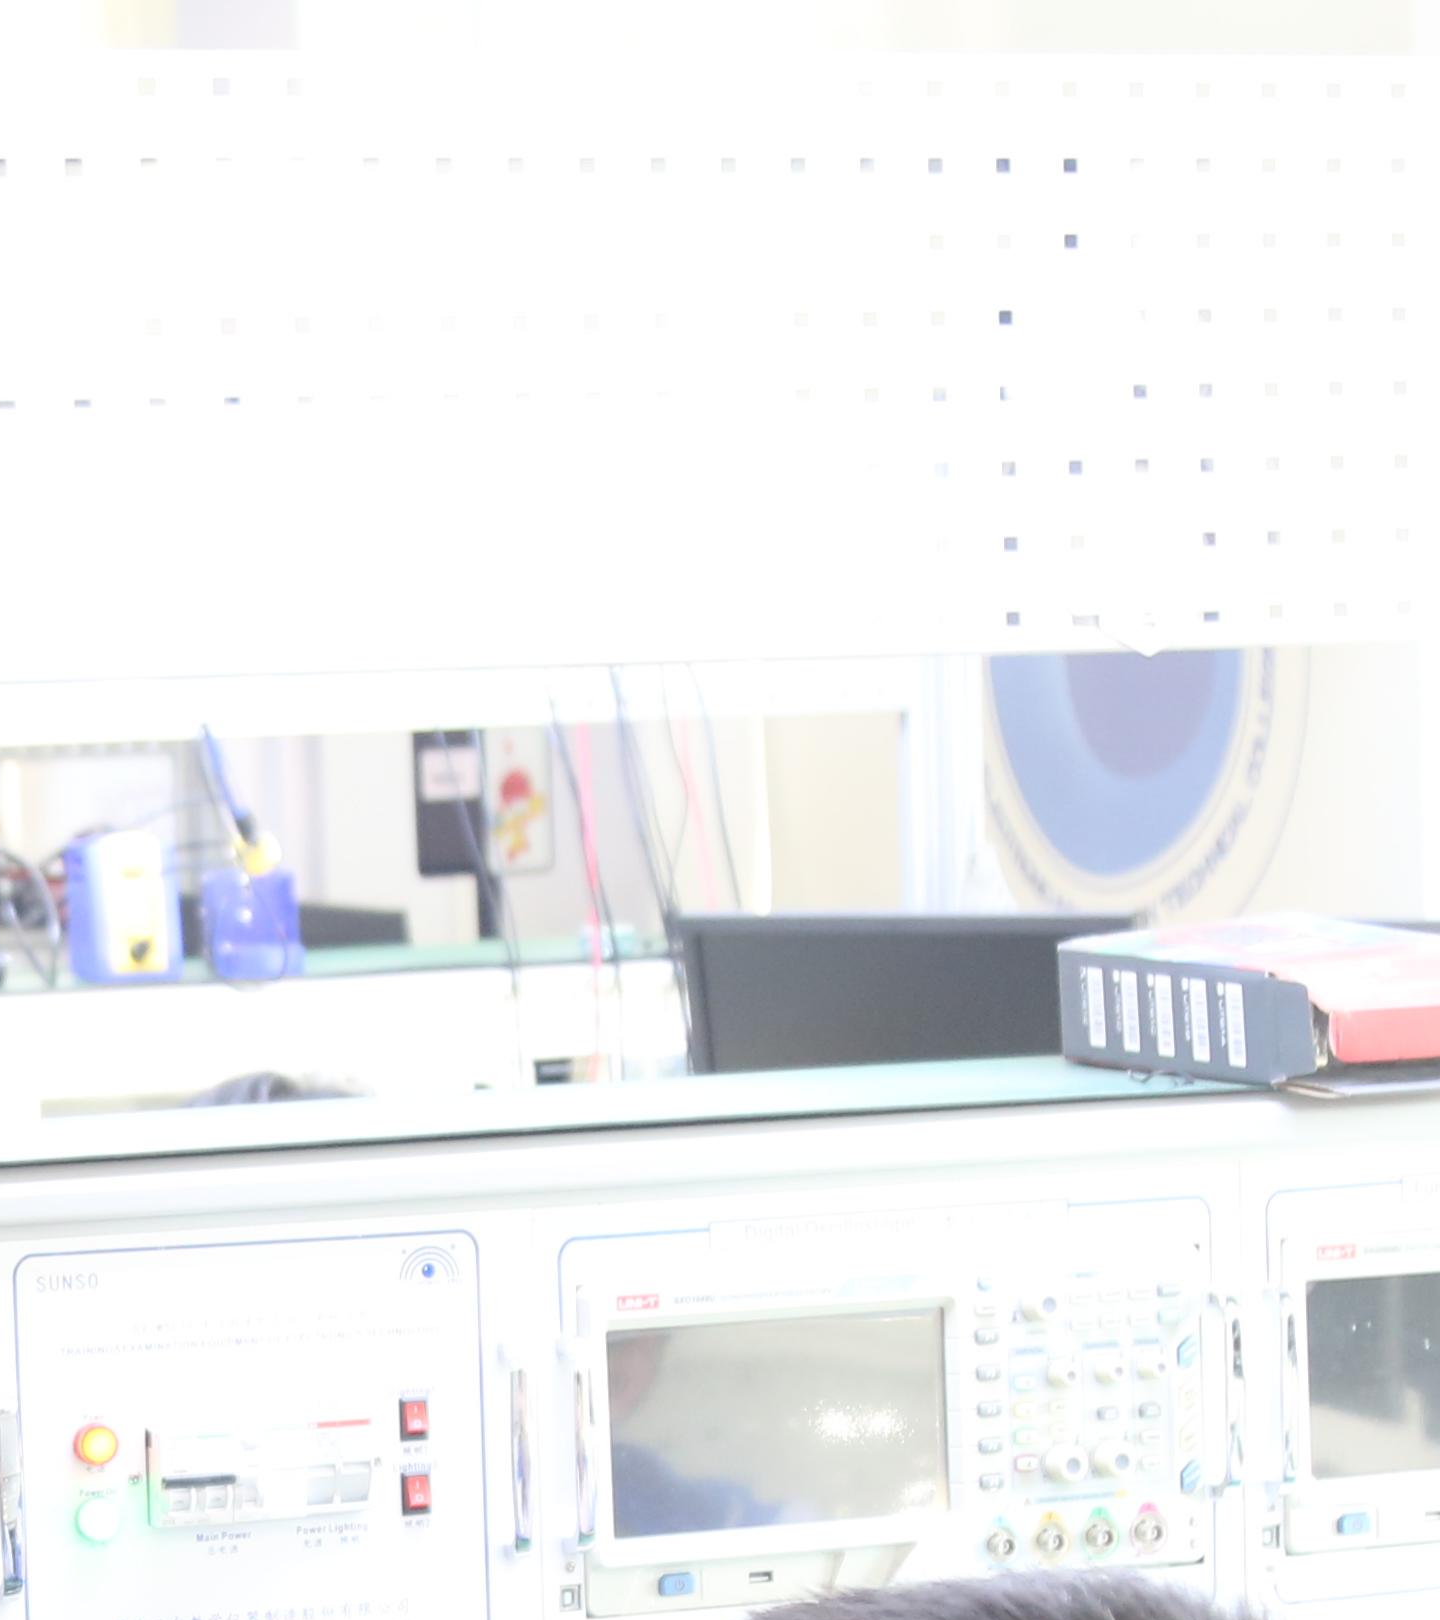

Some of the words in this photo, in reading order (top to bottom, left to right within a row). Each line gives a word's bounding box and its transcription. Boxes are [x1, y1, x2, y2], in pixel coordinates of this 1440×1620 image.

[36, 1272, 100, 1293] SUNSO
[618, 1295, 660, 1310] UNI-T
[195, 1532, 219, 1542] Main
[221, 1530, 252, 1541] Power
[296, 1524, 327, 1536] Power
[328, 1521, 369, 1535] Lighting
